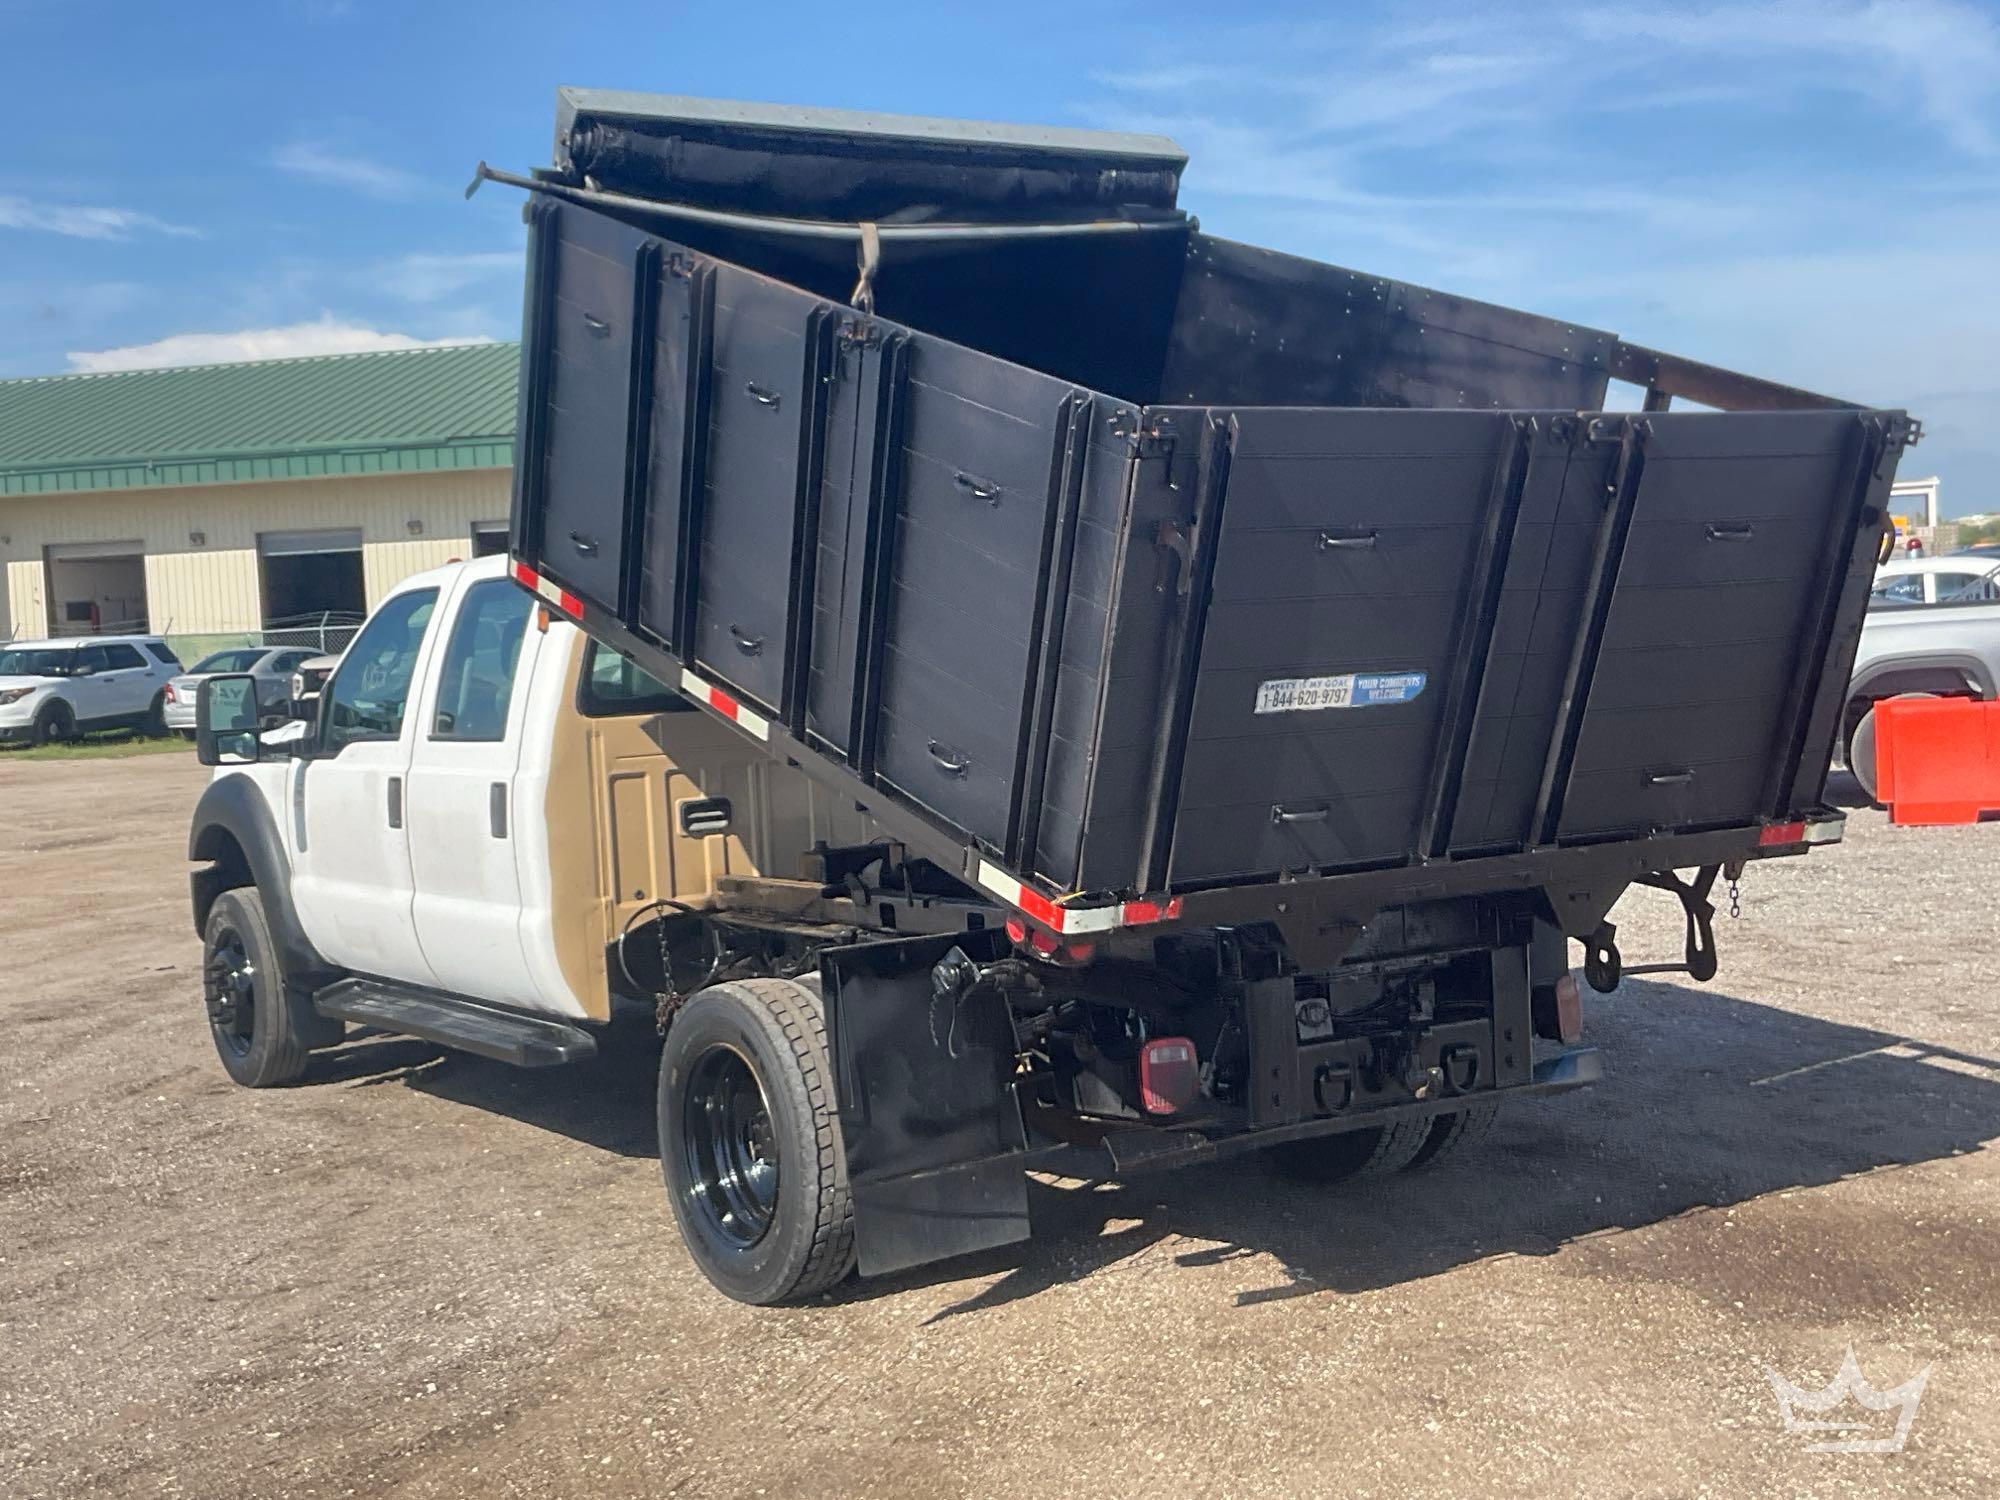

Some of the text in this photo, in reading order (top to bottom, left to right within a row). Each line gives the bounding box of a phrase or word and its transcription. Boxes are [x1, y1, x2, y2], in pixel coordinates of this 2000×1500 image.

[1309, 680, 1323, 688] MY
[1325, 679, 1348, 688] GOAL
[1358, 676, 1421, 689] YOUR COMMENTS
[1263, 688, 1348, 708] 1-844-620-9797
[1368, 688, 1406, 699] WELCOME
